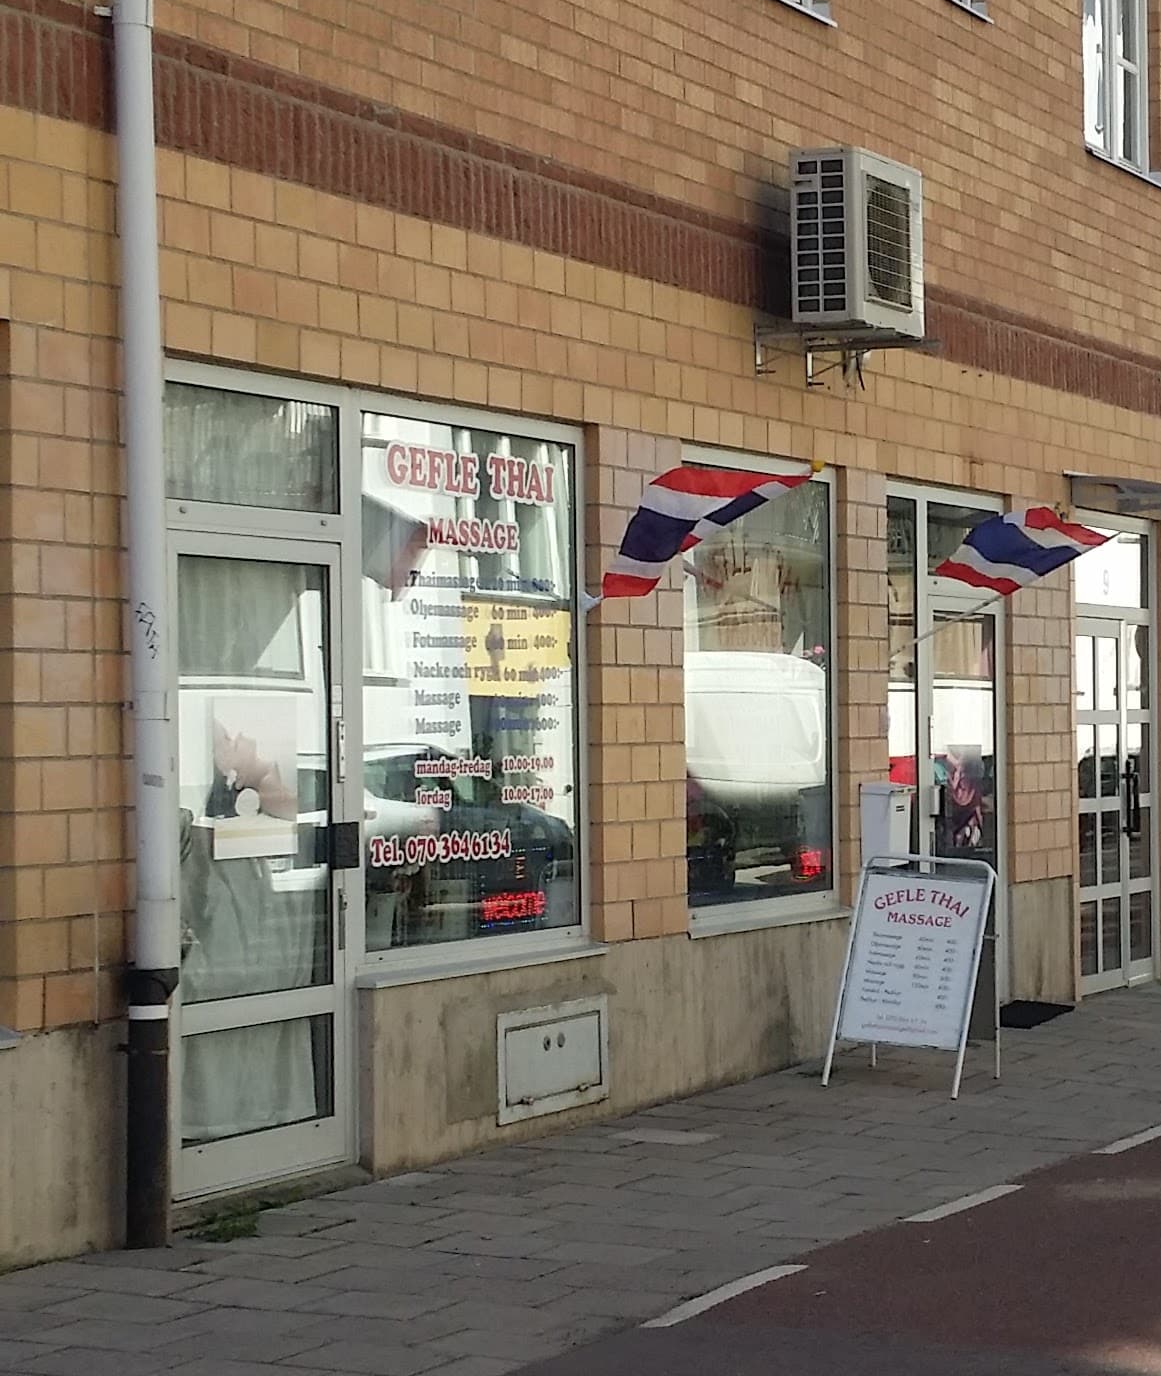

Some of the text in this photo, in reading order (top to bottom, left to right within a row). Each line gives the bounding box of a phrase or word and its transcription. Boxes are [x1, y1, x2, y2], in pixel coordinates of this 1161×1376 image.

[387, 443, 555, 503] GEFLE THAI
[428, 516, 519, 551] MASSAGE
[506, 605, 528, 620] min
[506, 634, 528, 650] min
[413, 661, 450, 679] Nacke
[452, 662, 472, 679] och
[414, 689, 461, 710] Massage
[415, 717, 462, 737] Massage
[407, 836, 437, 863] 070
[874, 888, 970, 918] GEFLE THAI
[887, 911, 952, 928] MASSAGE
